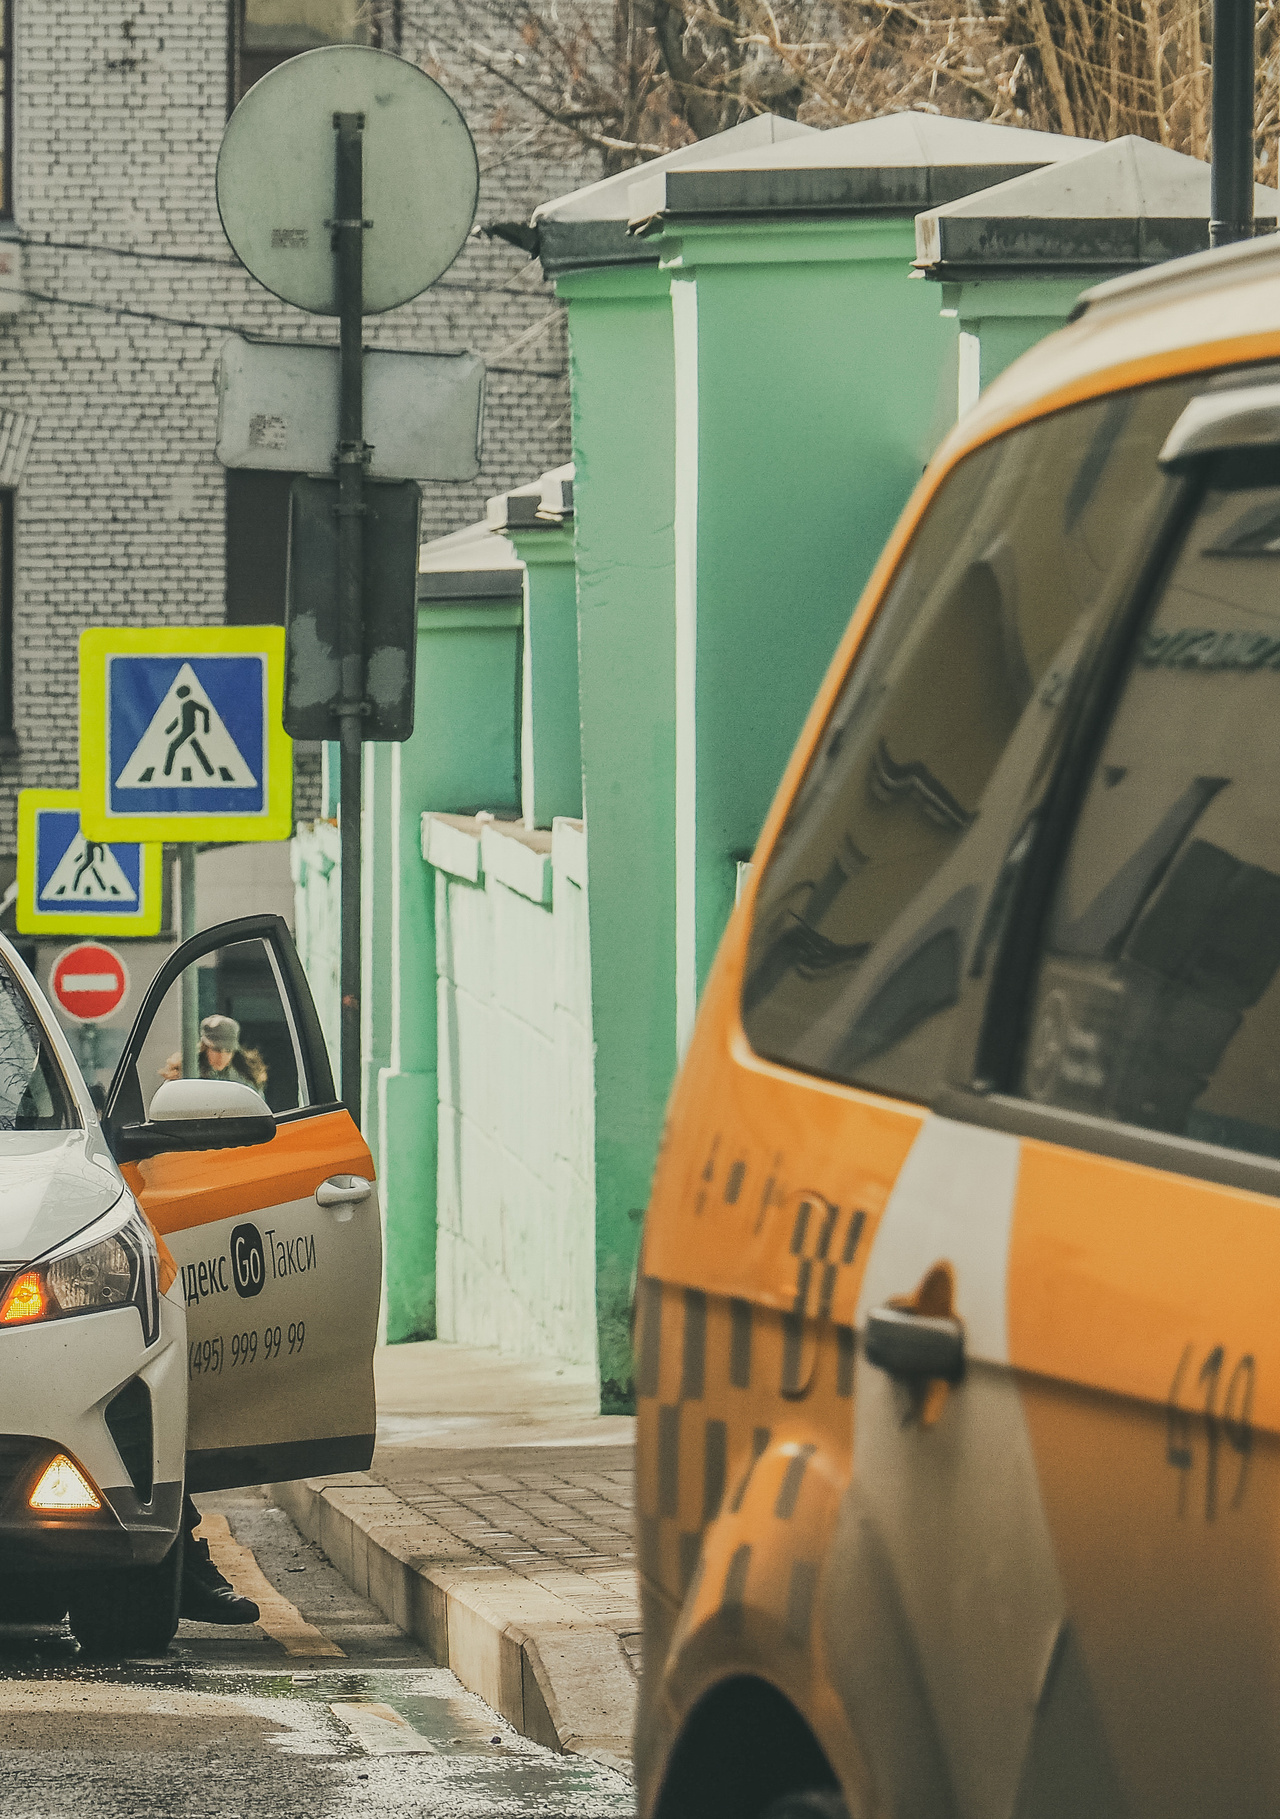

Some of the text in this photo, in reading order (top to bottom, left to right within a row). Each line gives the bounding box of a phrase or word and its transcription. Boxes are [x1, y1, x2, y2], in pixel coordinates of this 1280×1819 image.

[180, 1229, 318, 1308] декс Go Такси
[188, 1320, 307, 1381] (495) 999 99 99
